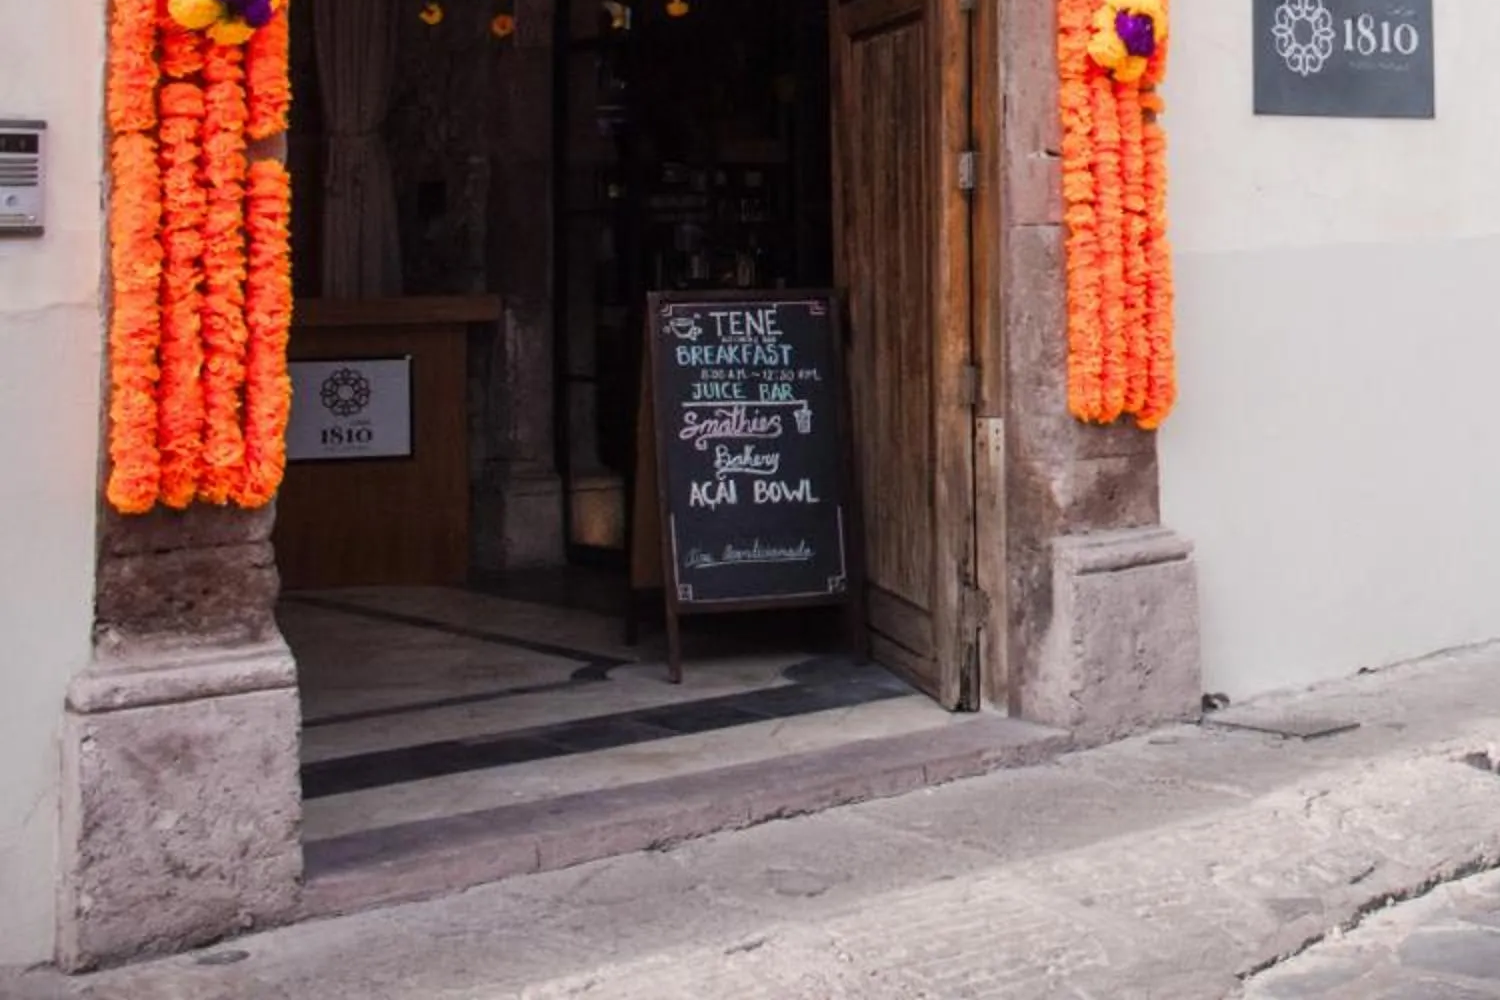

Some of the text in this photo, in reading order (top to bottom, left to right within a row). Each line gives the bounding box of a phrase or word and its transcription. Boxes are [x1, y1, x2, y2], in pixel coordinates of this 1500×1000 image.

[1343, 13, 1419, 56] 1810
[675, 343, 794, 367] BREAKFAST
[691, 382, 795, 400] JUICE BAR
[321, 427, 373, 444] 1810
[753, 479, 820, 504] BOWL
